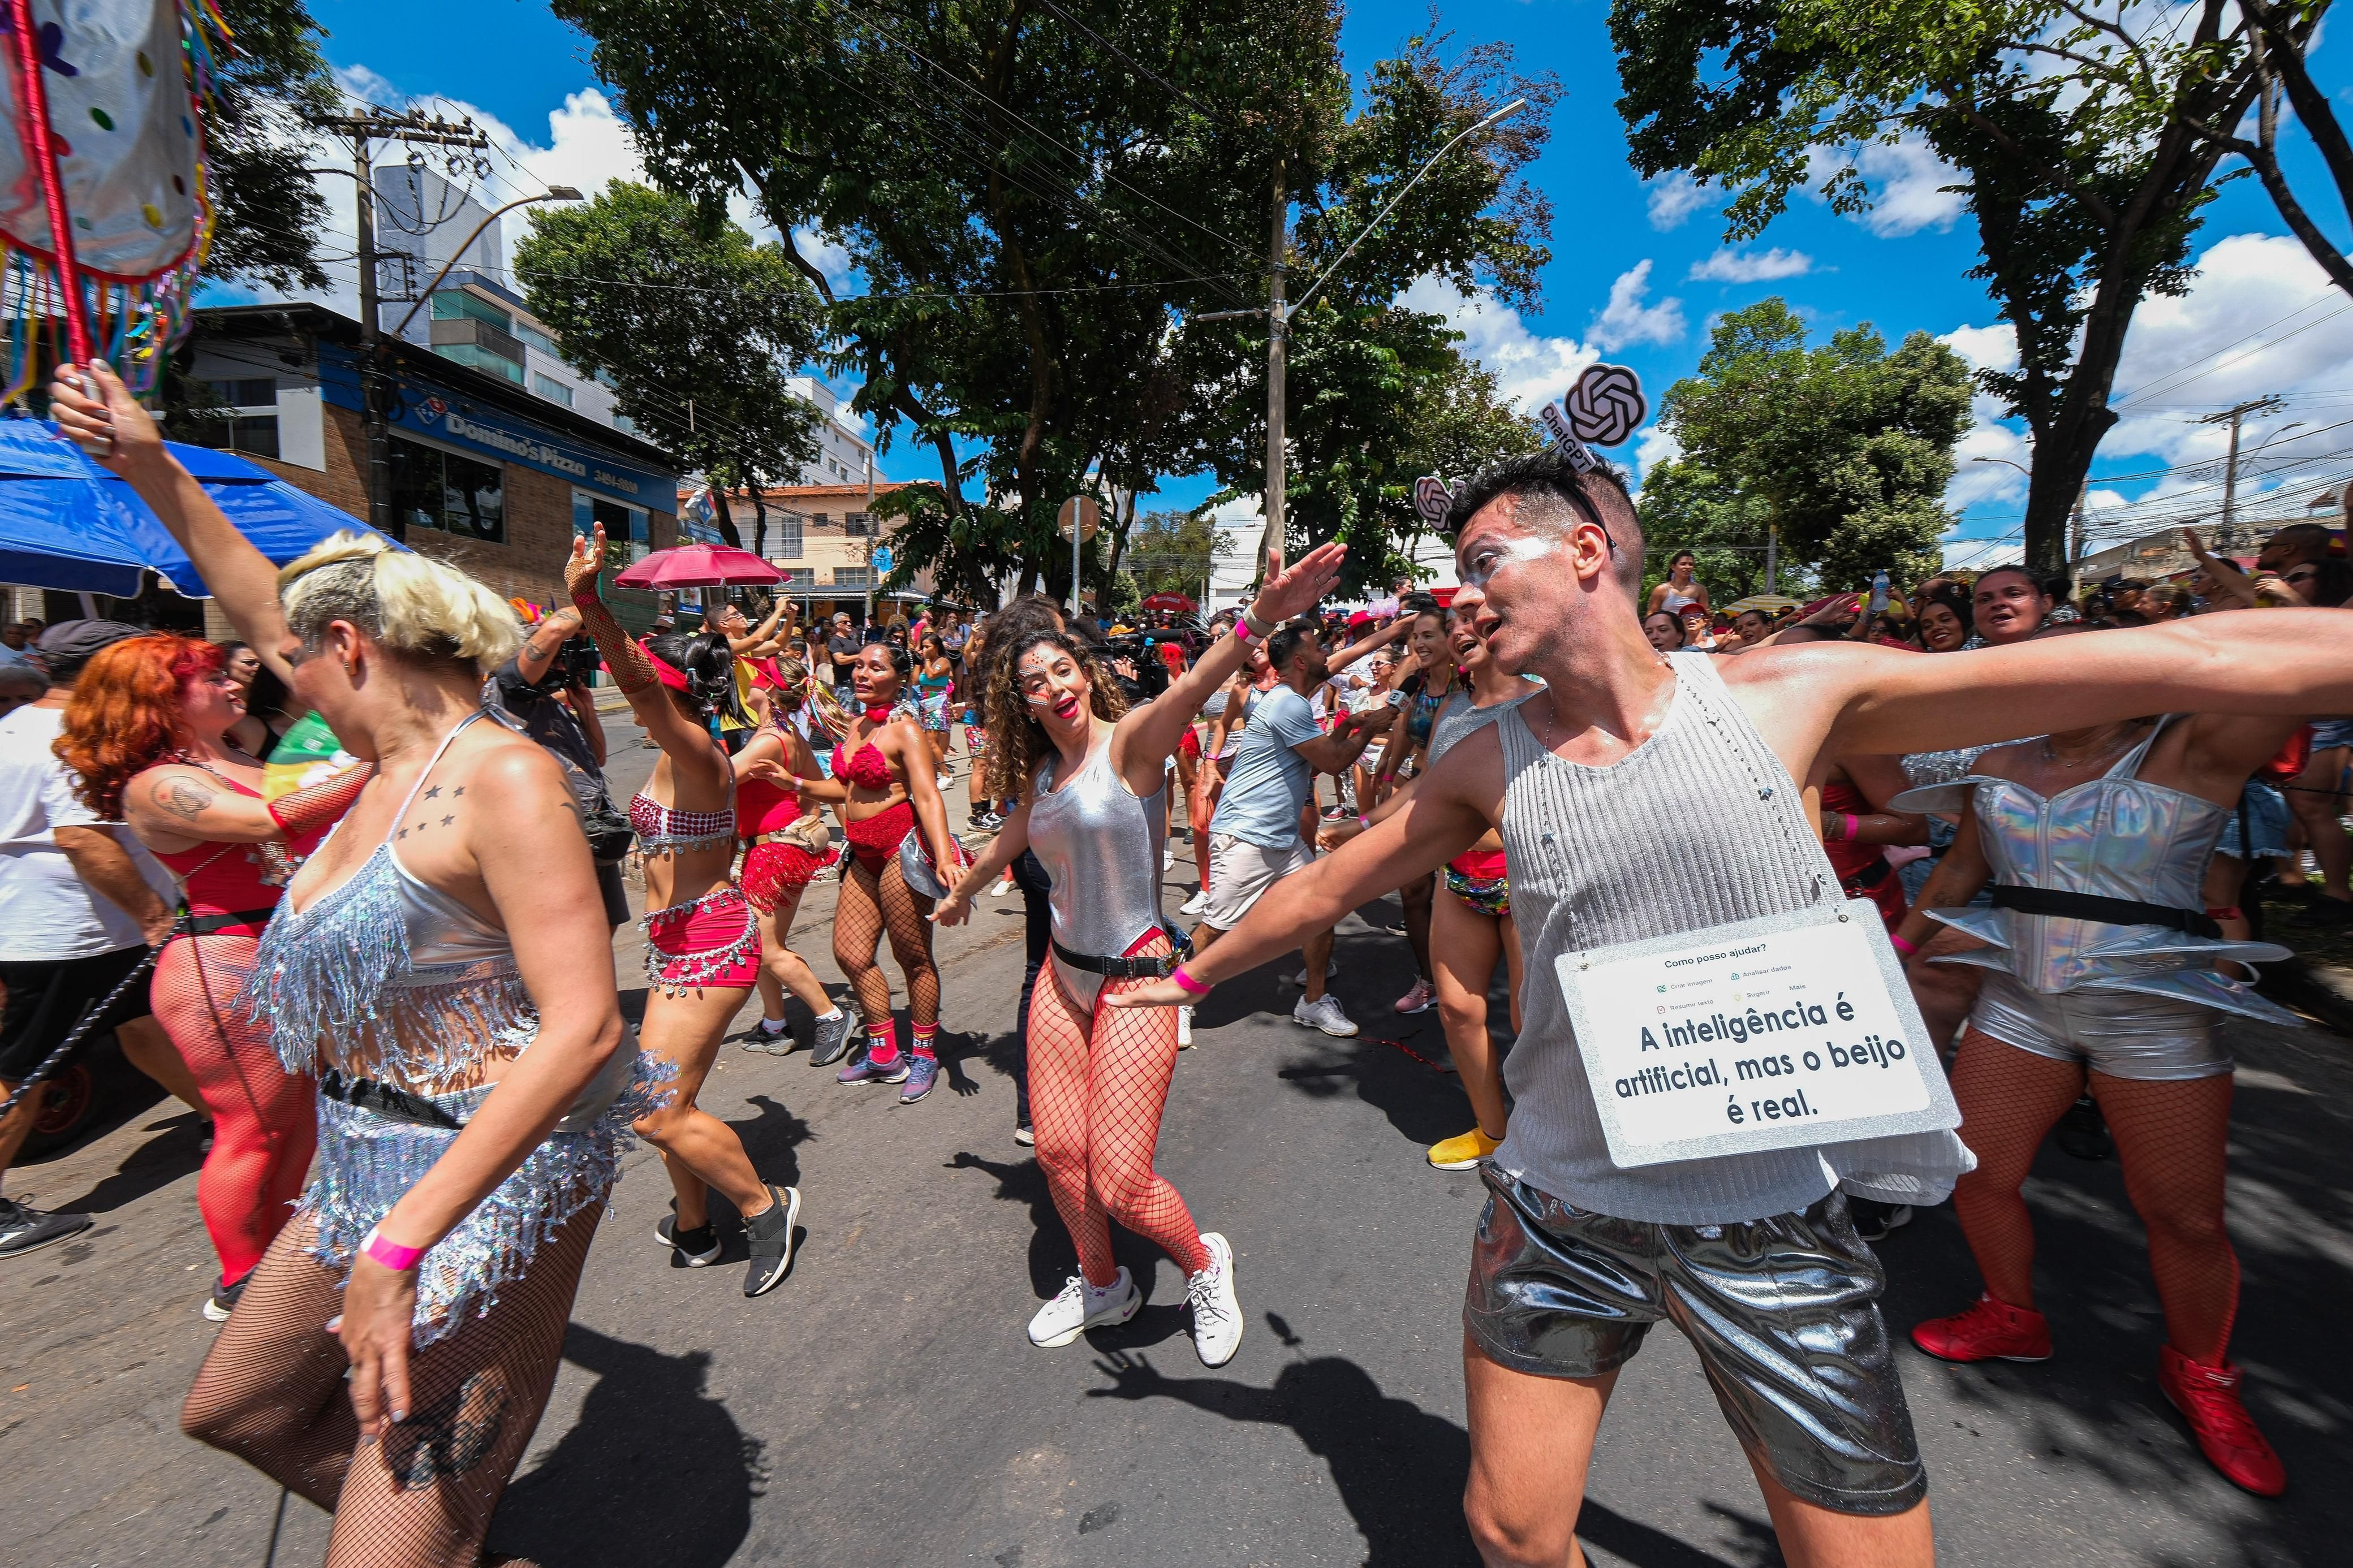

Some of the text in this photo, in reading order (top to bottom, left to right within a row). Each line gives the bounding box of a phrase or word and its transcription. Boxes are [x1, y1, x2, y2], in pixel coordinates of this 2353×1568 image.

[446, 413, 538, 461] Domino's
[539, 446, 586, 477] Pizza
[1542, 407, 1591, 469] ChatGPT
[1665, 944, 1766, 968] Como posso ajudar?
[1687, 978, 1713, 987] imagem
[1743, 965, 1792, 978] Analisar dados
[1670, 1003, 1696, 1011] Resumir
[1746, 990, 1770, 999] Sugerir
[1641, 991, 1855, 1052] A inteligência é
[1615, 1034, 1906, 1098] artificial, mas o beijo
[1727, 1088, 1818, 1124] é real.
